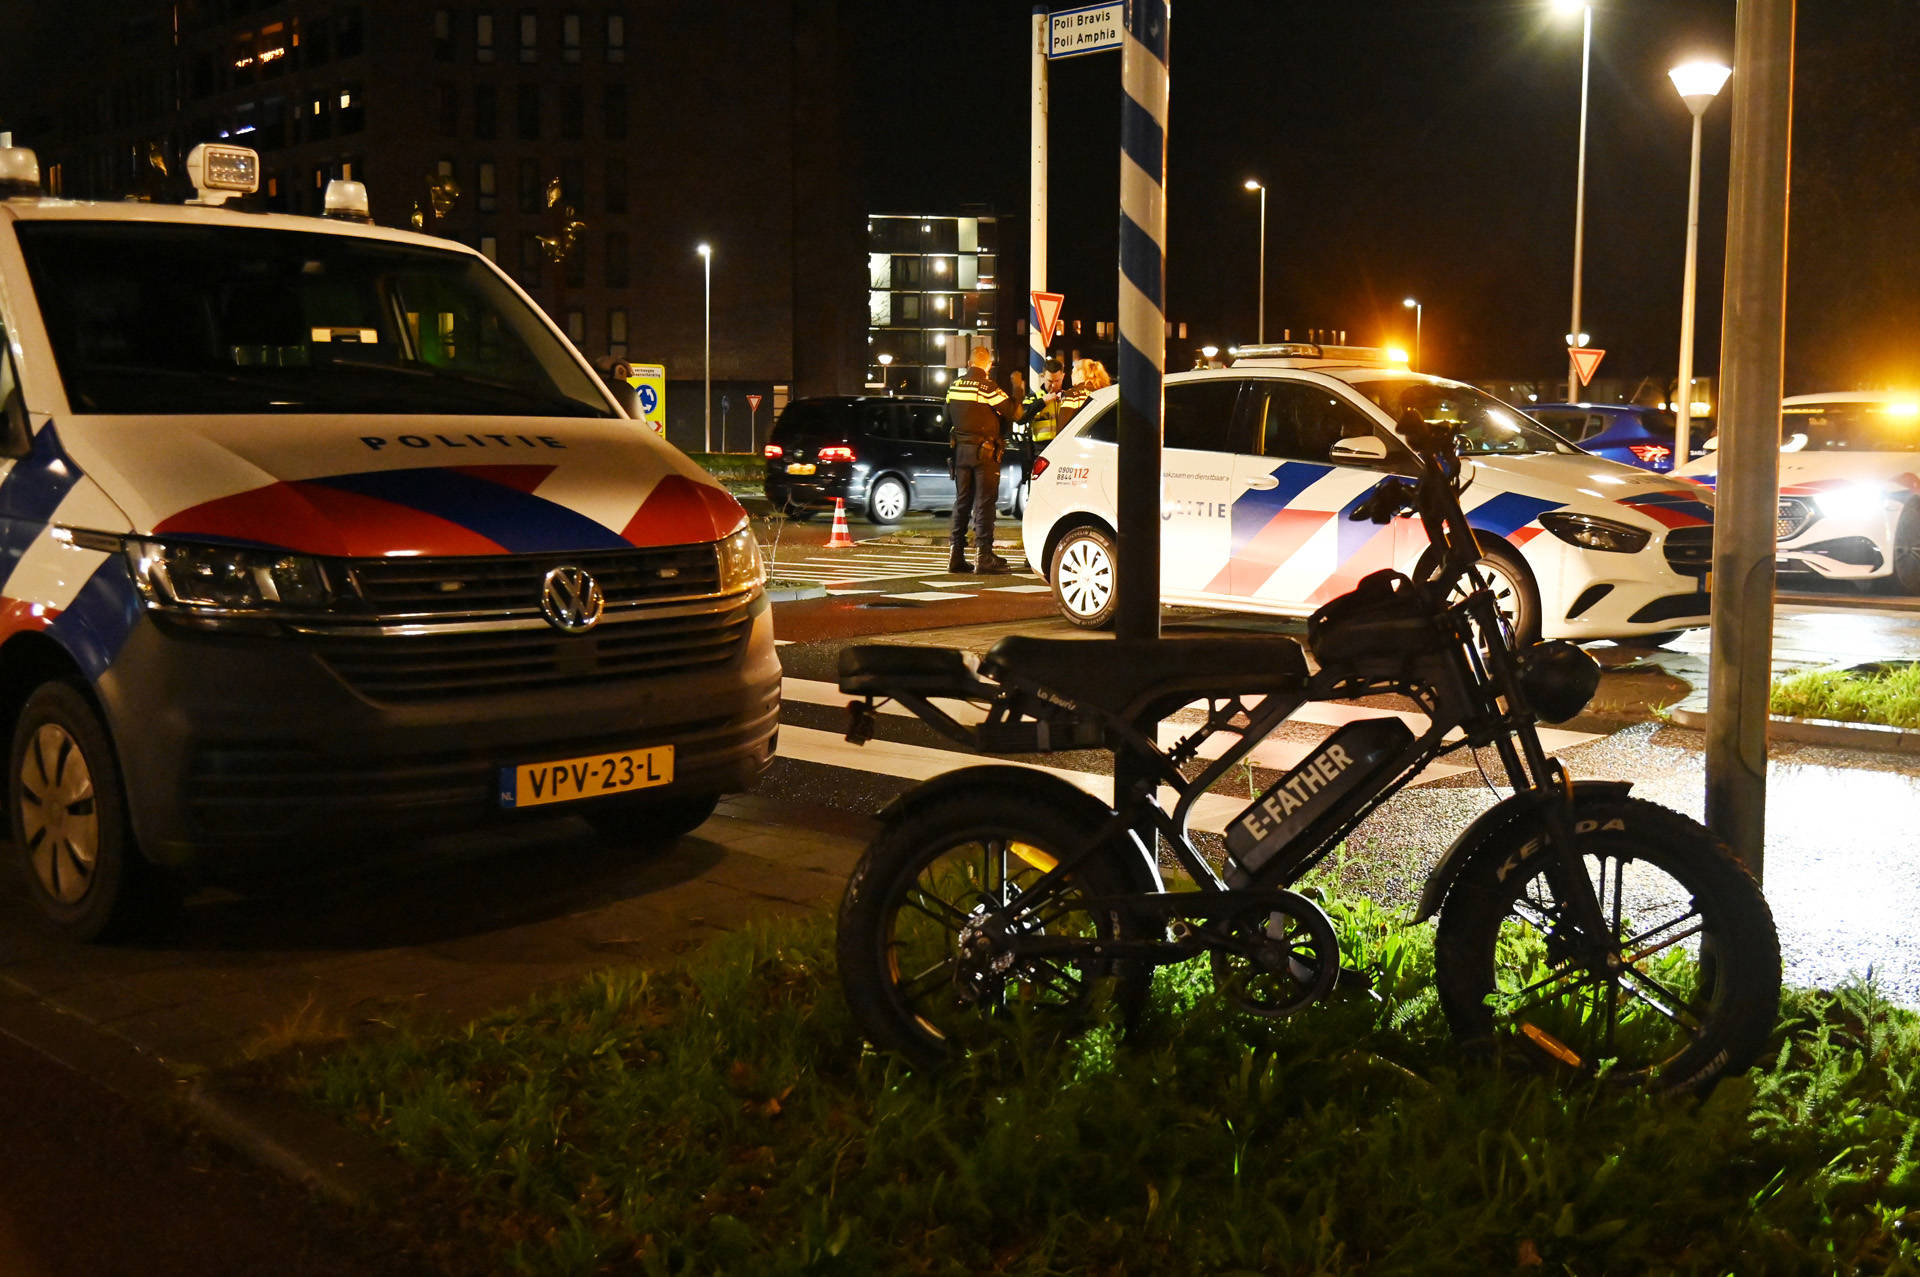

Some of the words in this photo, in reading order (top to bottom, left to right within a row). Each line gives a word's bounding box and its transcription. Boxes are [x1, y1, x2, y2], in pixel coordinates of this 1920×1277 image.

[1054, 17, 1073, 30] Poli
[1077, 11, 1110, 26] Bravis
[1054, 35, 1073, 48] Poli
[1077, 28, 1116, 44] Amphia
[360, 434, 568, 451] POLITIE
[1073, 468, 1089, 479] 112
[528, 753, 661, 799] VPV-23-L
[1241, 743, 1354, 842] E-FATHER
[1496, 818, 1625, 882] KEDA
